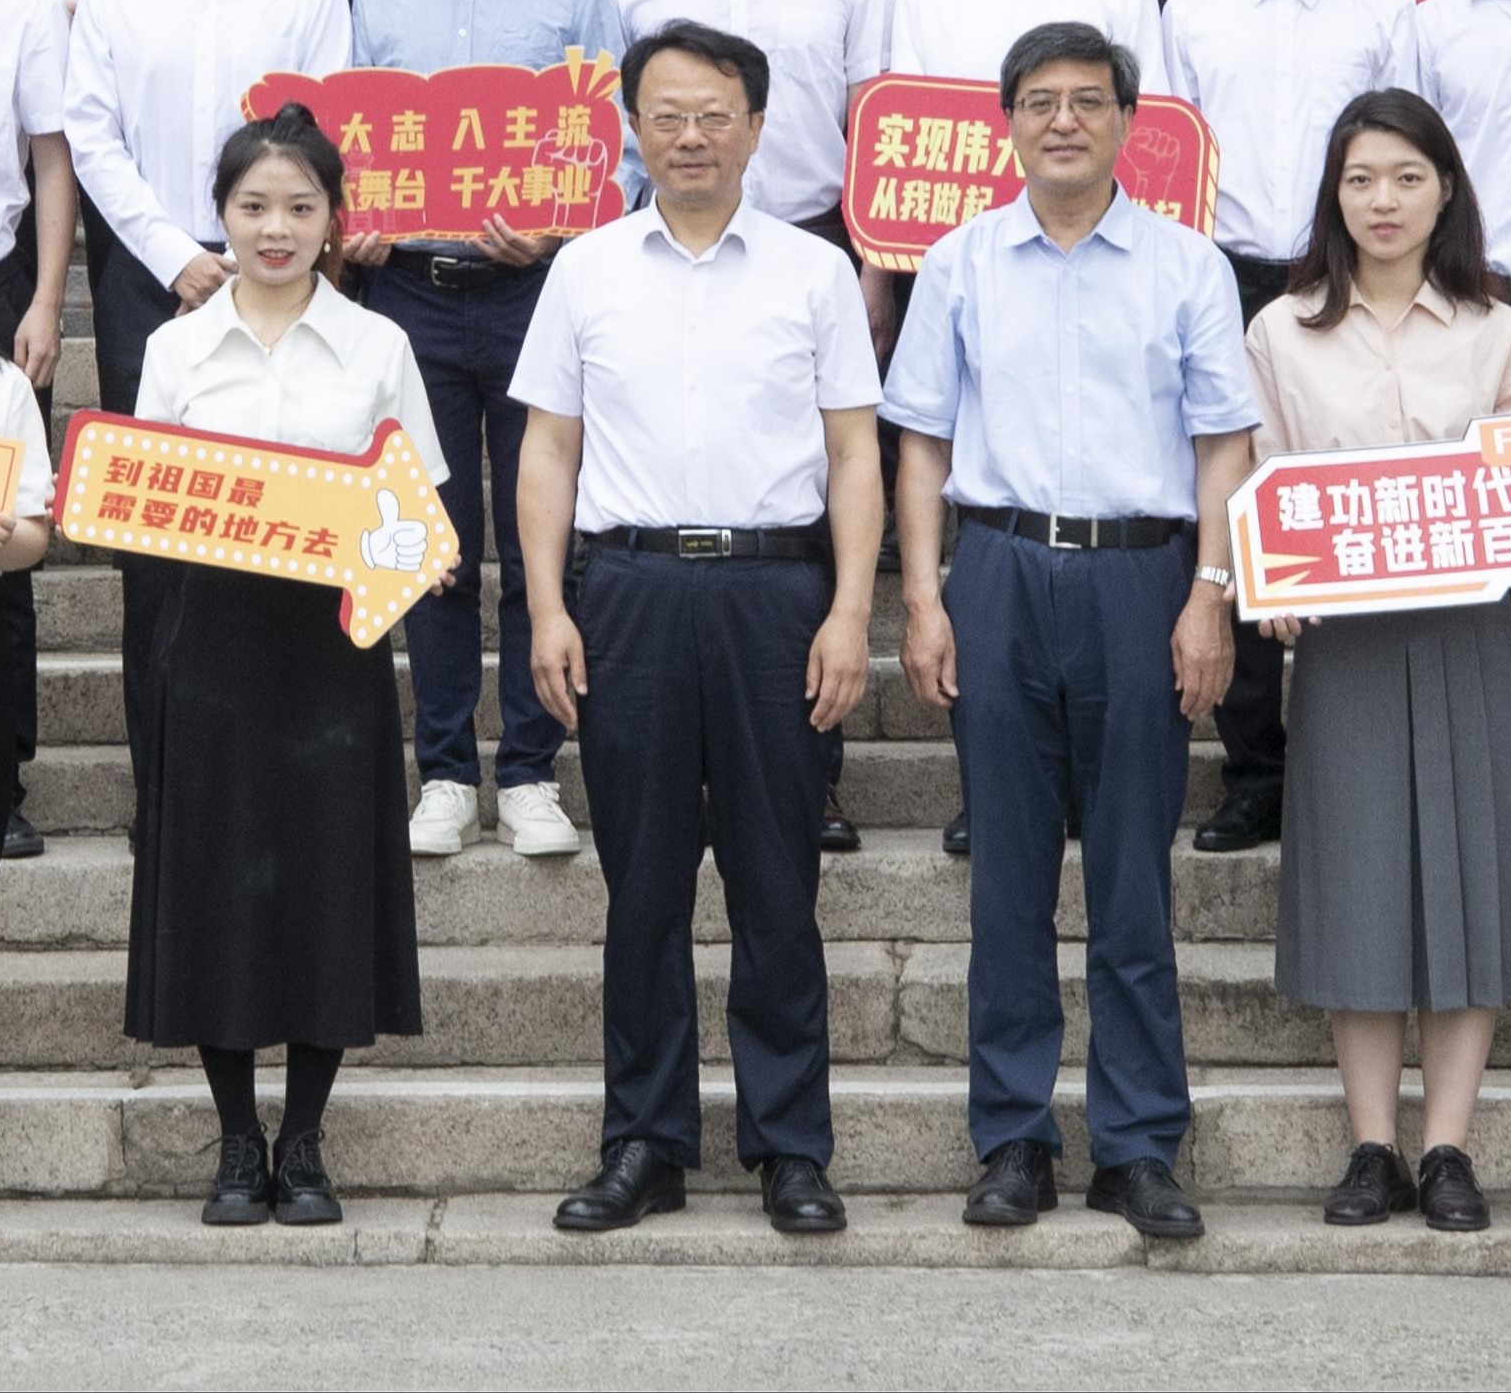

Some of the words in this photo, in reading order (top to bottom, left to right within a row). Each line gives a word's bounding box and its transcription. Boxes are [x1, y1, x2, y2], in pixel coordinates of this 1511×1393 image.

[103, 455, 266, 509] 到祖国最
[97, 491, 340, 559] 需要的地方去
